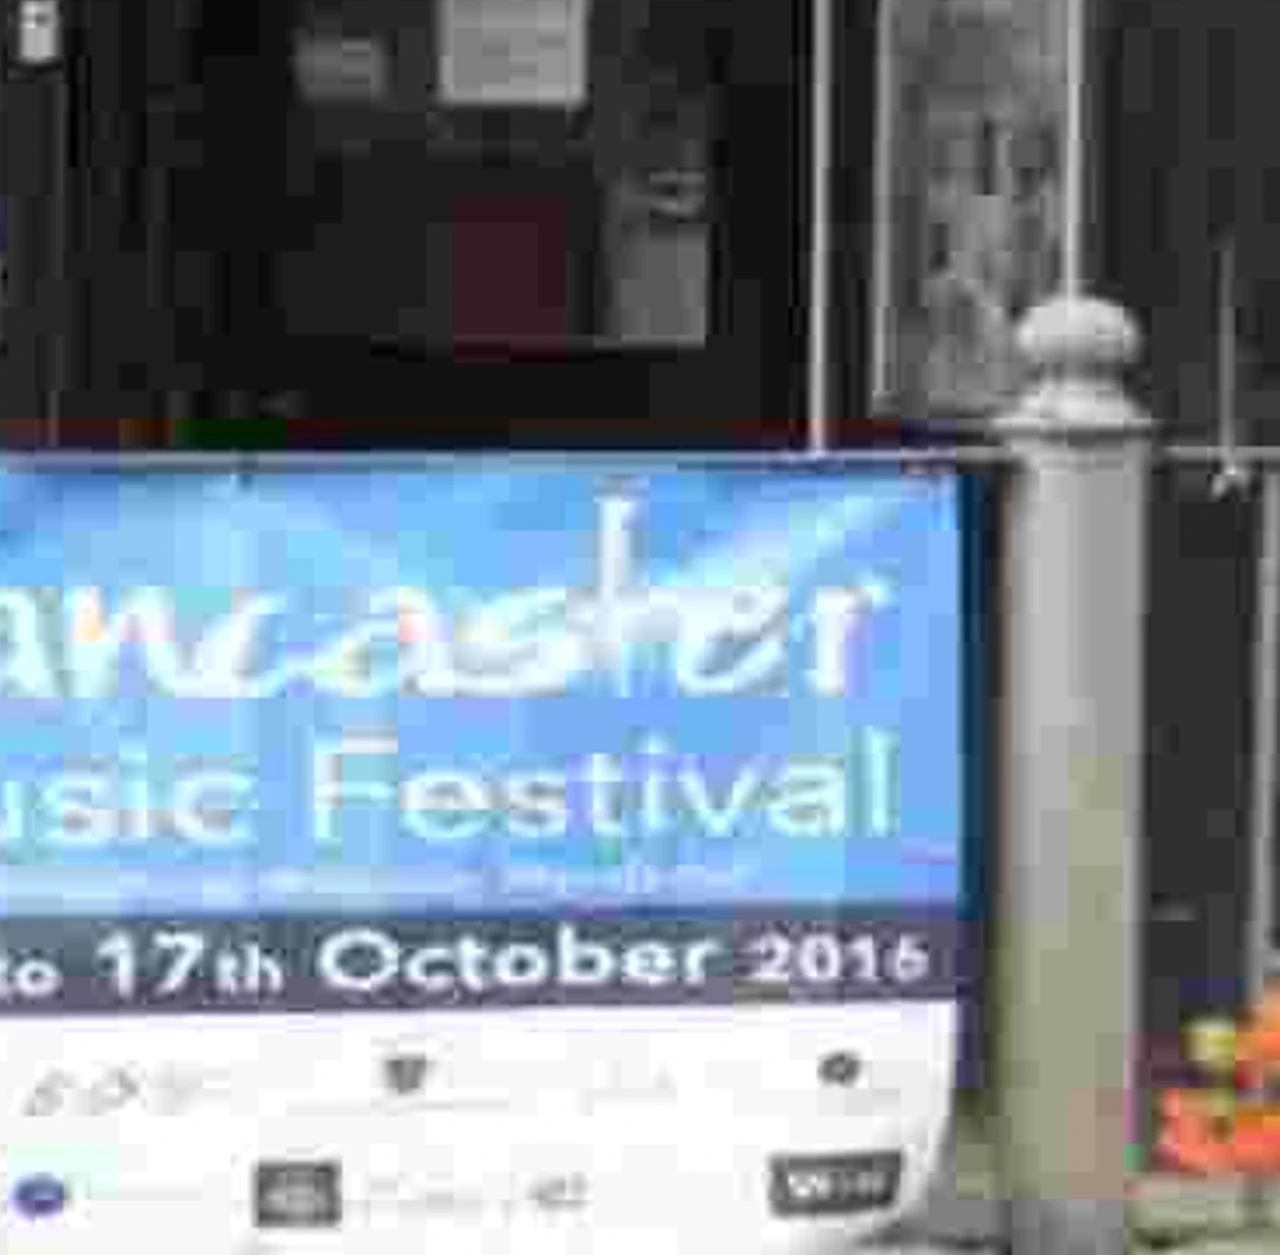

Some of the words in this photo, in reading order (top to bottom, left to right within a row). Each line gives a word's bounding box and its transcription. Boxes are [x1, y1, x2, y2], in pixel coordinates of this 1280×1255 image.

[308, 729, 900, 840] Festival
[95, 930, 284, 995] 17th
[317, 922, 720, 993] October
[749, 933, 930, 985] 2016
